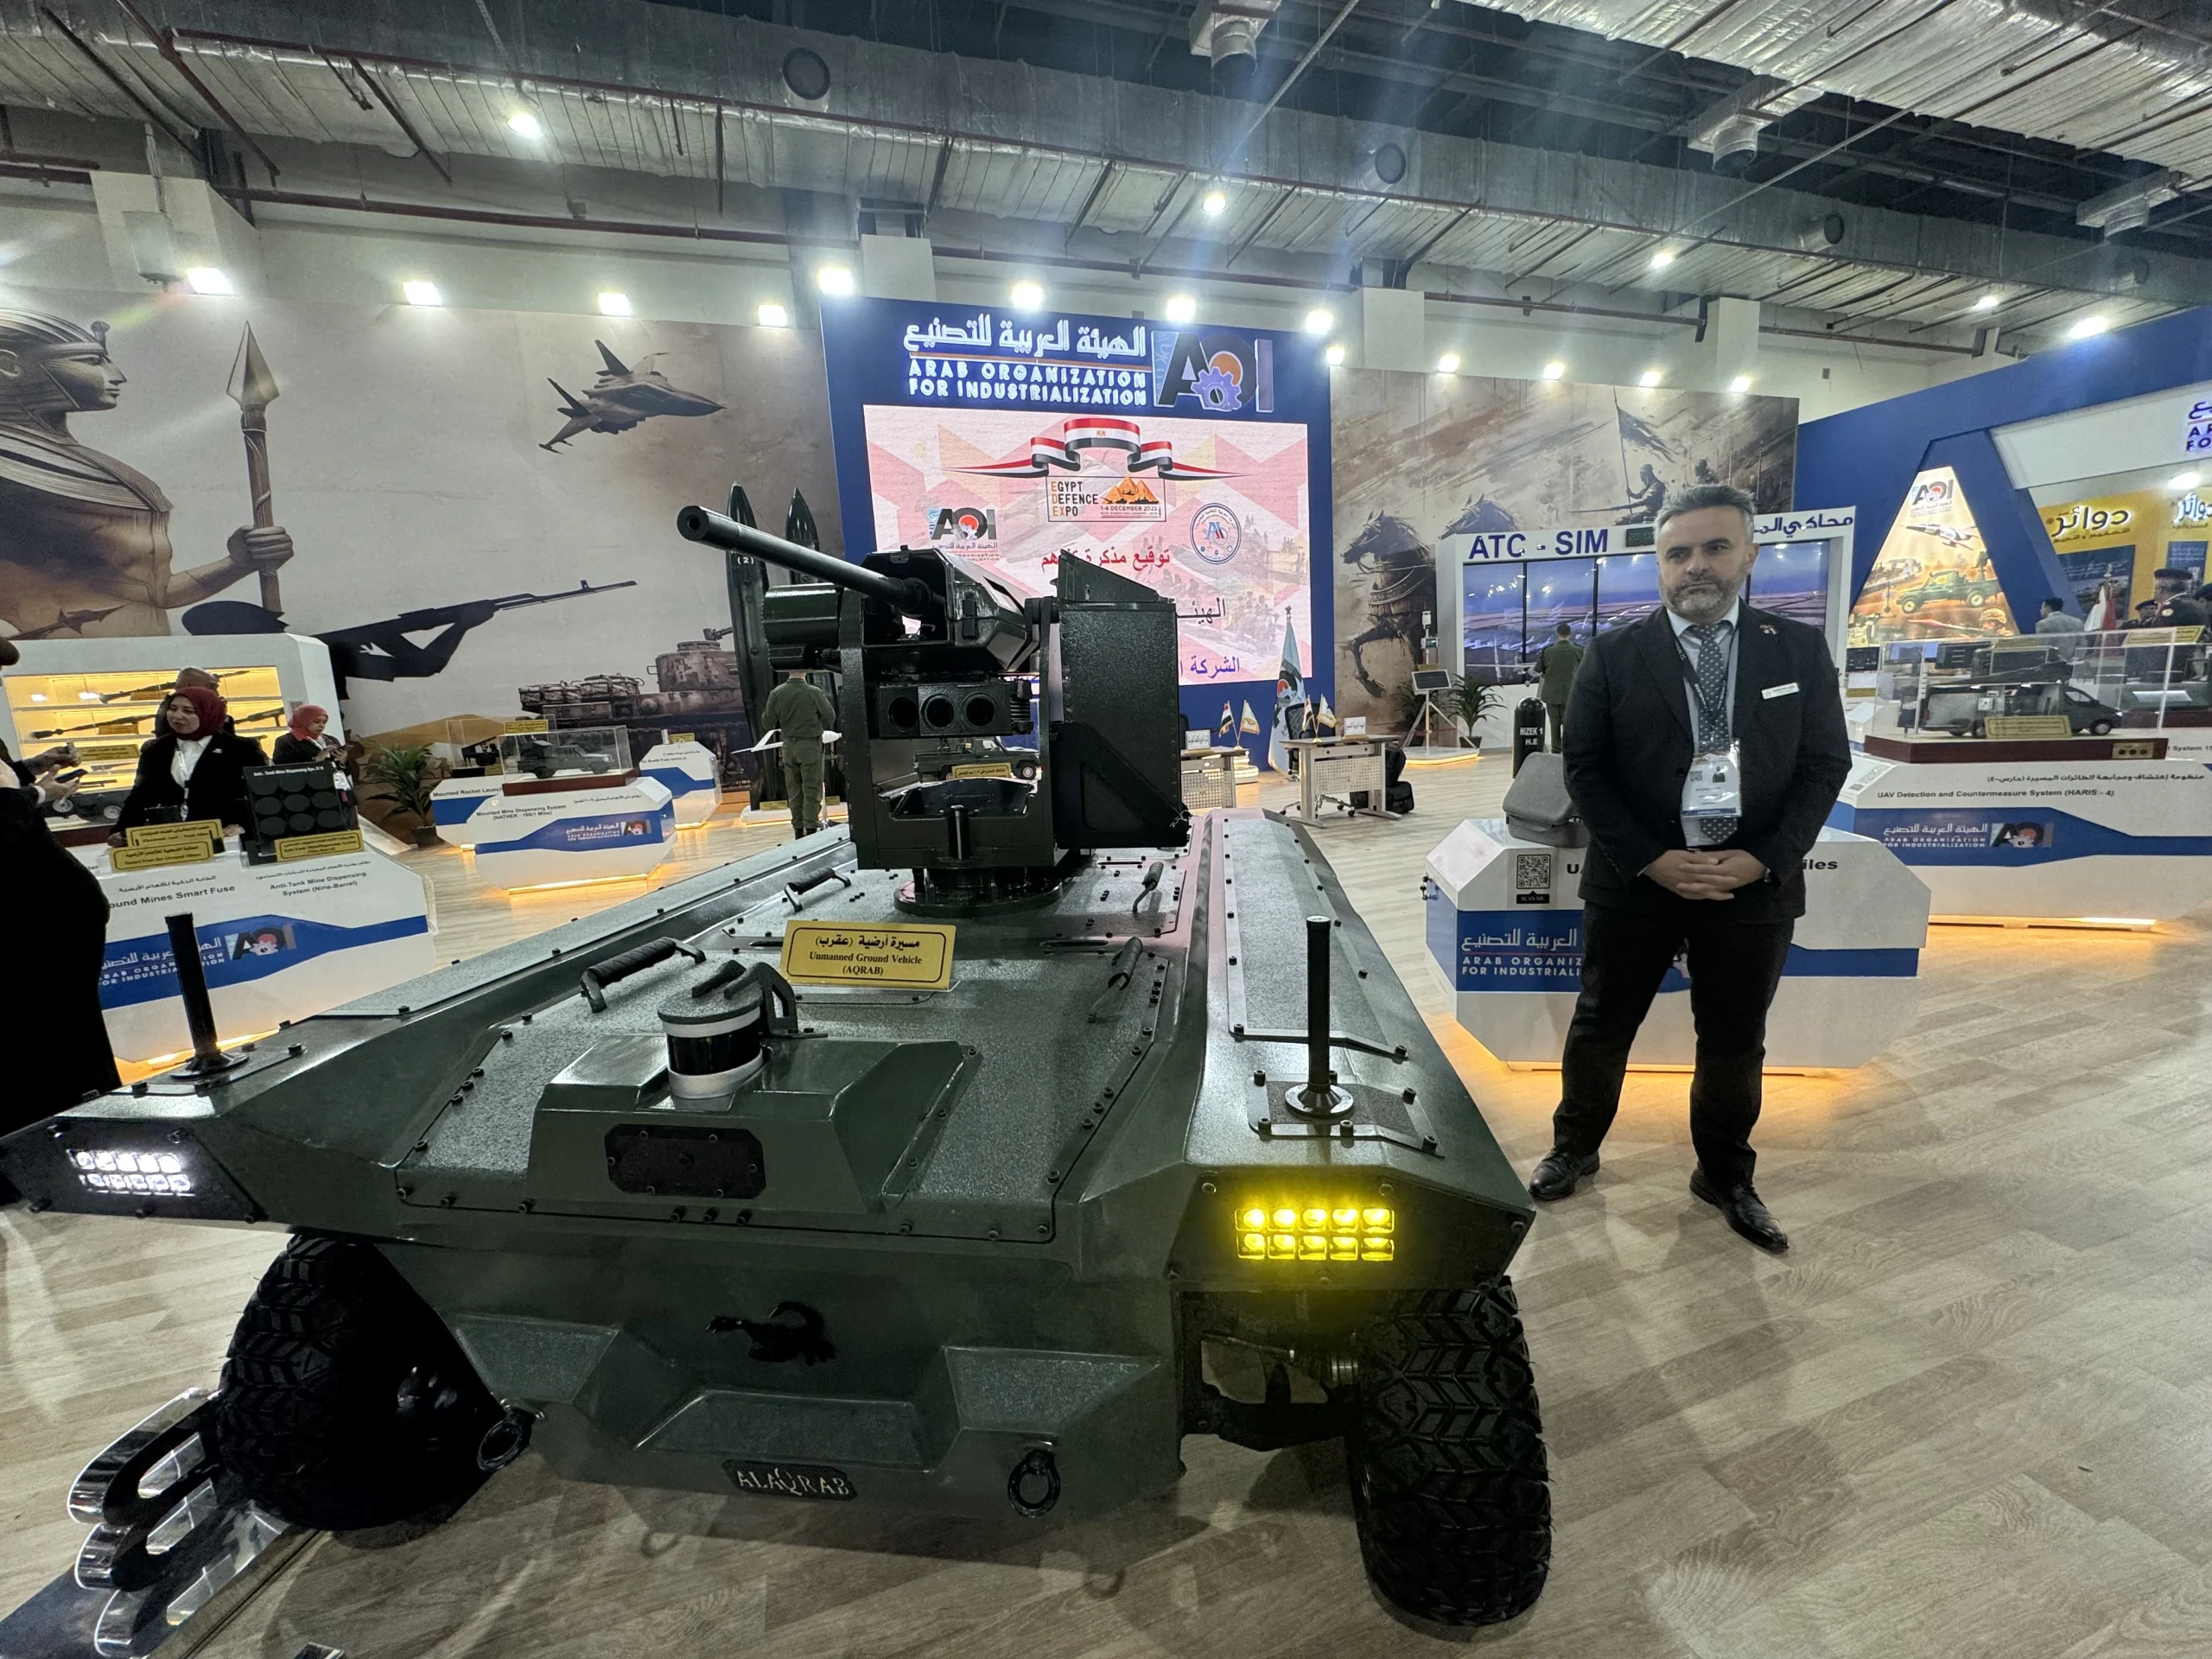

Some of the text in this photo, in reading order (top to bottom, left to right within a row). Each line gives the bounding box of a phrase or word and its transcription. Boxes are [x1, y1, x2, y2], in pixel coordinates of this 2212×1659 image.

[903, 313, 1147, 359] الهيئة العربية للتصنيع
[909, 359, 1147, 389] ARAB ORGANIZATION
[909, 378, 1147, 405] FOR INDUSTRIALIZATION
[1051, 481, 1083, 492] EGYPT
[1052, 493, 1098, 505] DEFENCE
[1052, 506, 1078, 517] EXPO
[931, 507, 996, 539] AOI
[1783, 513, 1853, 538] محاكي
[2051, 506, 2130, 537] دوائر
[1469, 533, 1526, 559] ATC
[1554, 529, 1609, 555] SIM
[737, 556, 754, 565] (2)
[1133, 546, 1170, 571] توقيع
[1177, 597, 1225, 624] الهيئ
[1190, 655, 1240, 678] الشركة
[1922, 823, 1953, 835] العربية
[1955, 823, 1987, 834] الهيئة
[270, 880, 306, 890] Anti-Tank
[327, 872, 366, 881] Dispensing
[283, 880, 358, 896] System (Nine-Barrel)
[109, 886, 235, 908] ound Mines Smart Fuse
[815, 934, 919, 950] مسيرة أرضية (عقرب)
[1461, 928, 1578, 951] العربية للتصنيع
[810, 951, 922, 964] Unmanned Ground Vehicle
[1463, 957, 1582, 966] ARAB ORGANIZ
[99, 967, 127, 981] RAB
[842, 965, 884, 976] (AQRAB)
[1462, 966, 1580, 976] FOR INDUSTRIALI
[101, 977, 118, 986] OR
[737, 1468, 849, 1496] ALAQRAB
